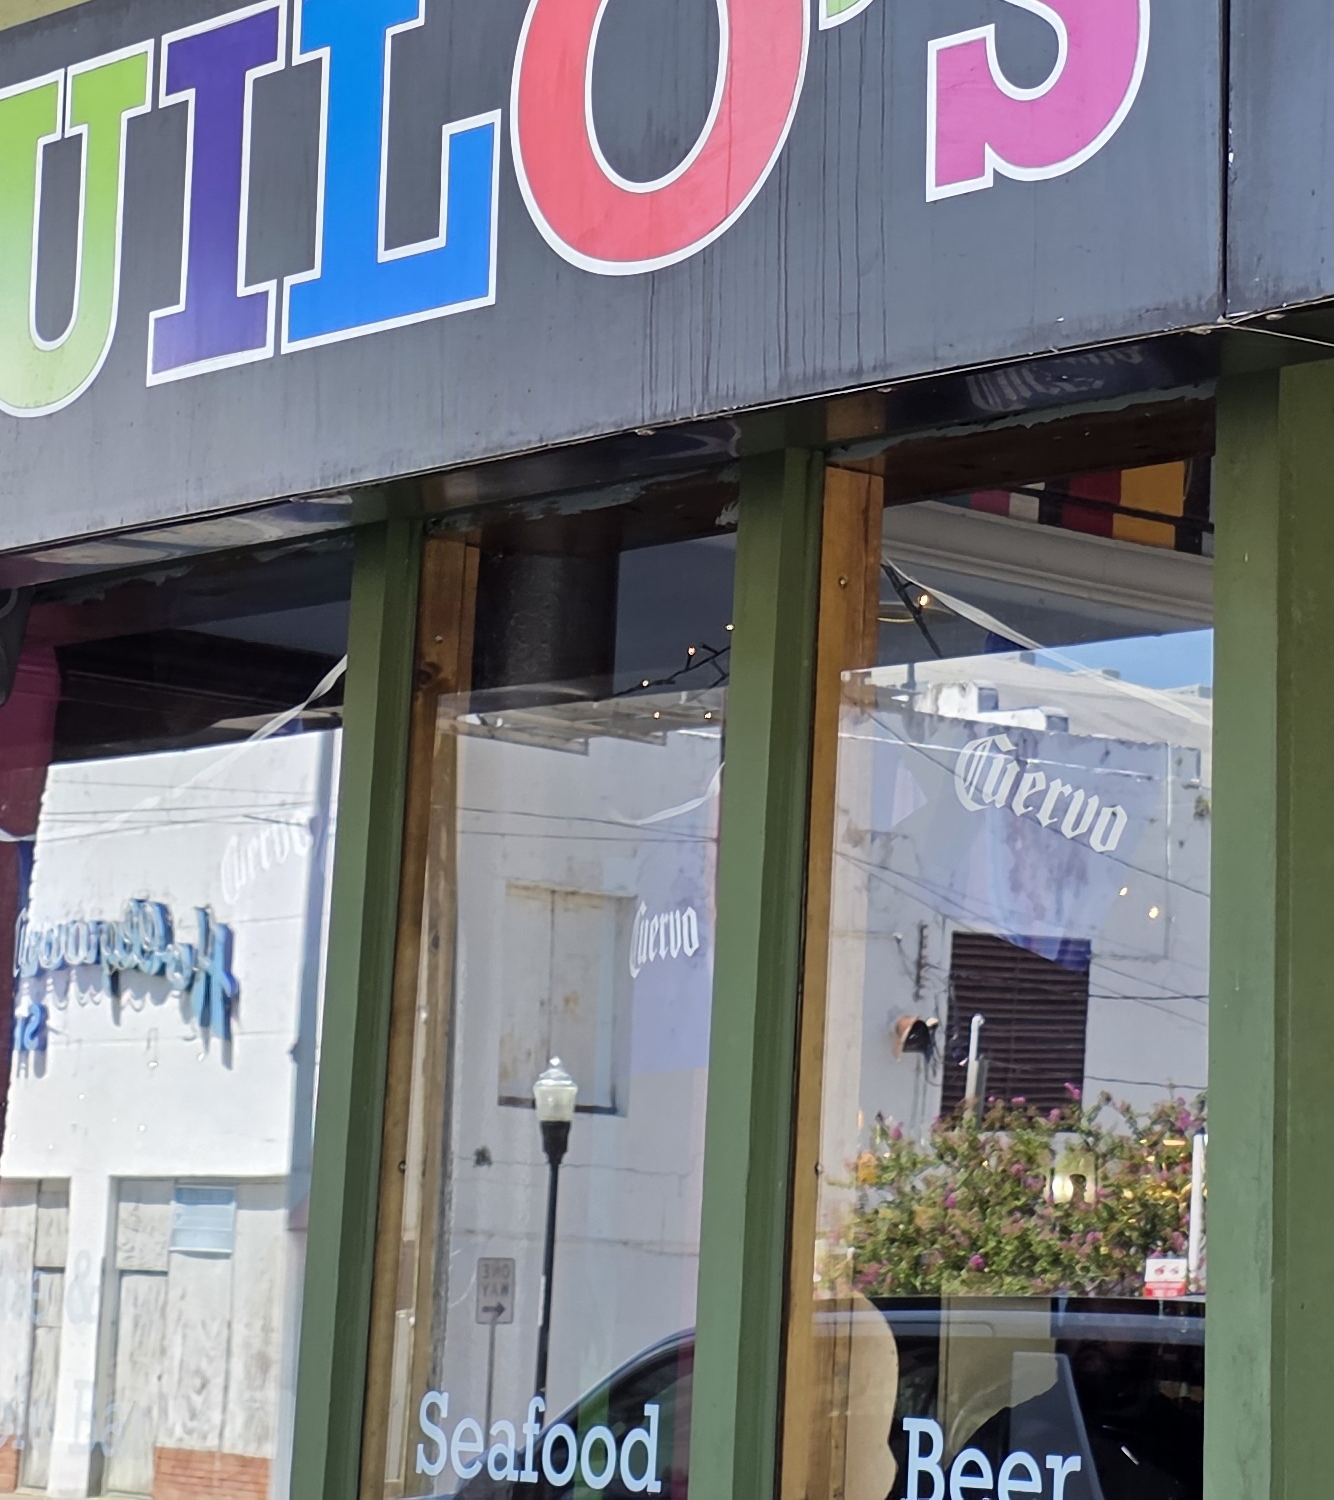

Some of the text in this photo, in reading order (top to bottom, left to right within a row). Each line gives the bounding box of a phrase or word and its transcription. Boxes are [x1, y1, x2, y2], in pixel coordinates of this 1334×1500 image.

[954, 733, 1128, 853] Cuervo
[629, 900, 700, 979] Cuervo
[415, 1389, 662, 1494] Seafood
[901, 1416, 1082, 1500] Beer
